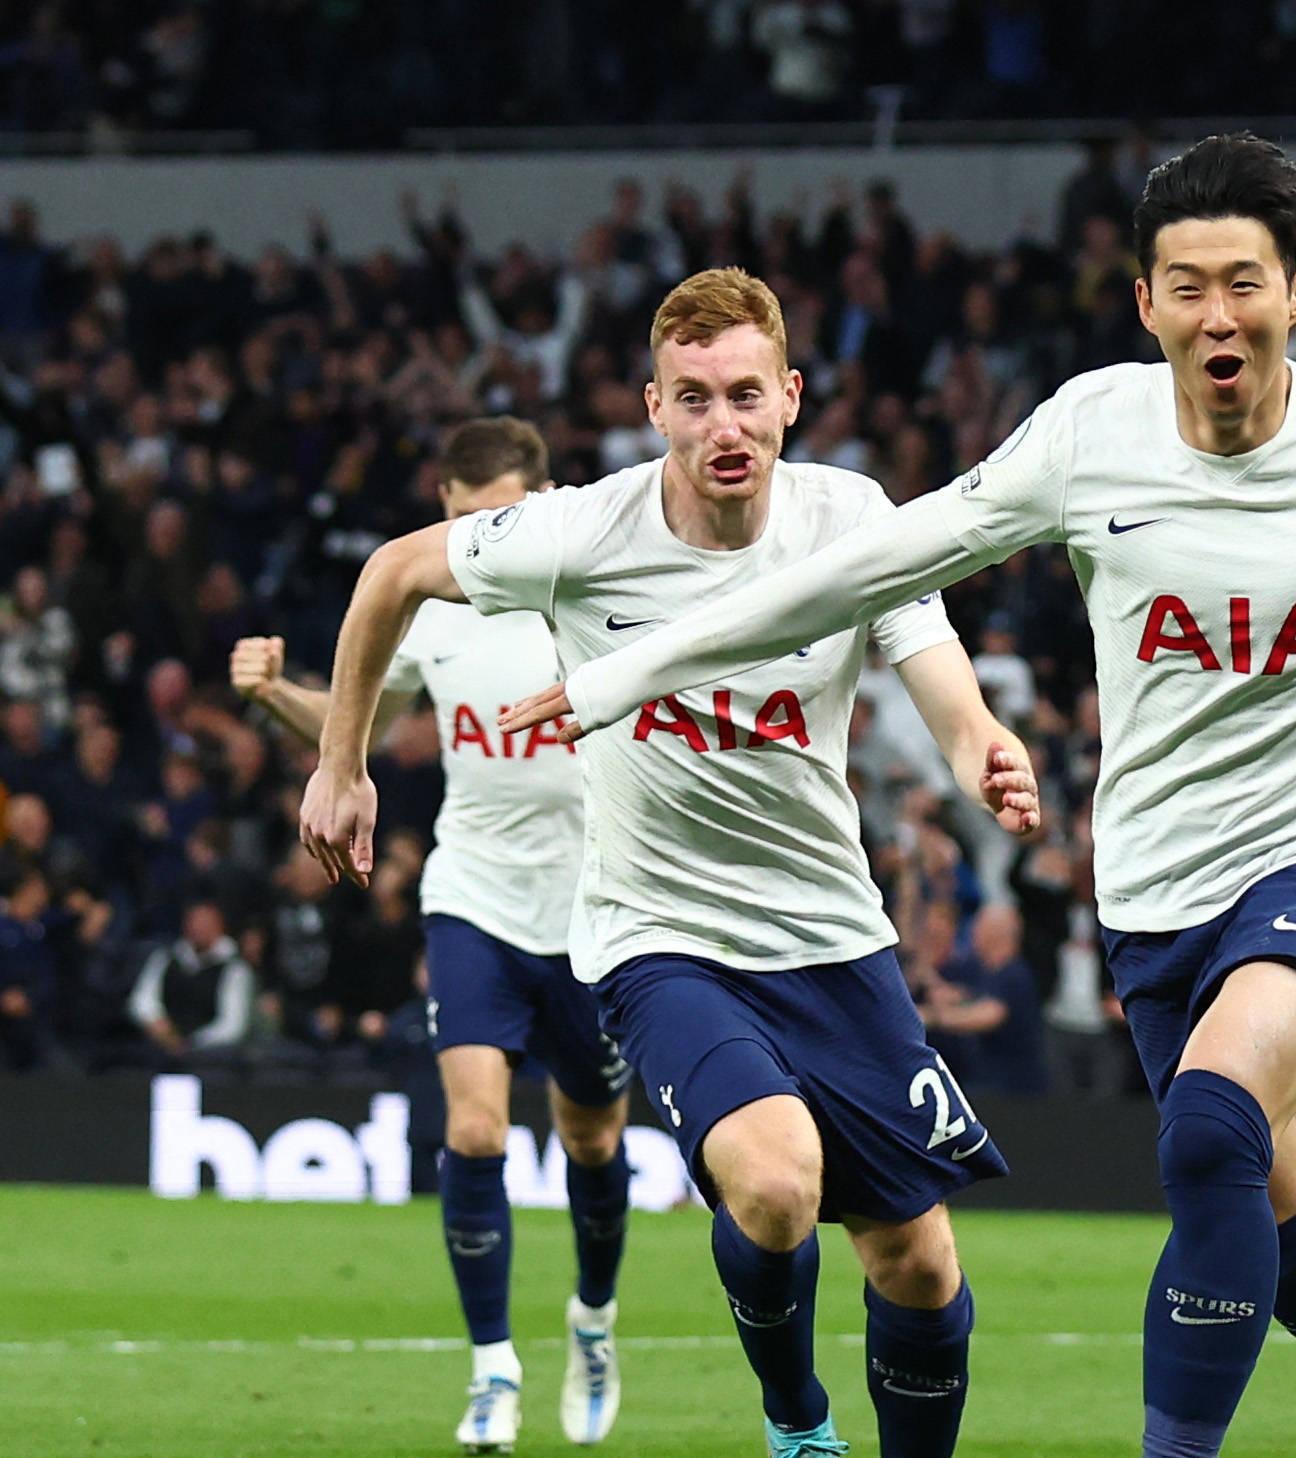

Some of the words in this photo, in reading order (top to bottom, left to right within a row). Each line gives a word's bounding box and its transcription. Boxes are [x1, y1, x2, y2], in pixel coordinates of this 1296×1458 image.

[631, 690, 812, 753] AIA
[909, 1053, 977, 1151] 21
[1165, 1287, 1256, 1317] SPURS
